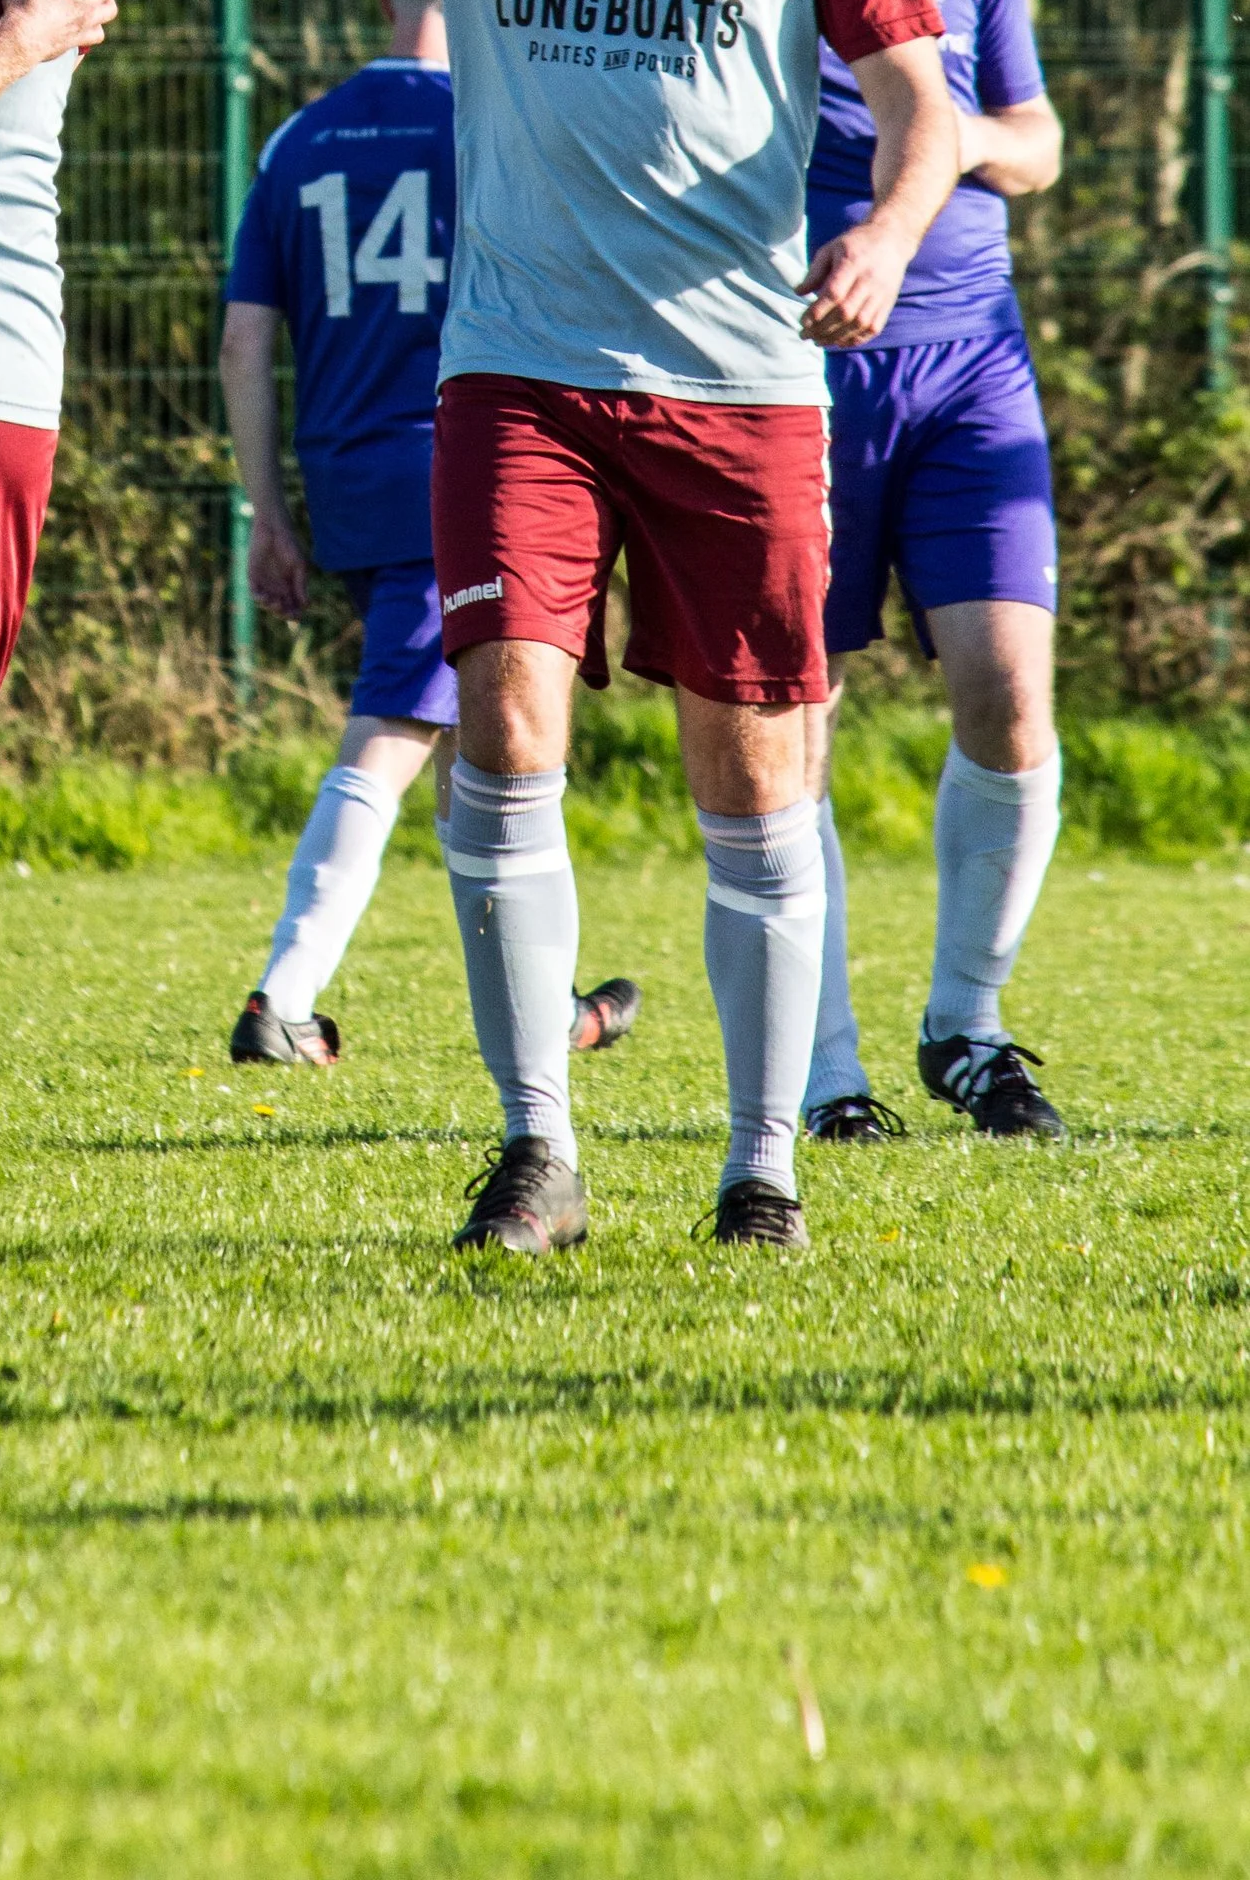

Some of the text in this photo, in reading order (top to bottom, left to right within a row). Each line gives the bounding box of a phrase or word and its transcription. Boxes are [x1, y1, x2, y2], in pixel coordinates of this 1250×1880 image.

[528, 40, 697, 78] PLATES AND POURS
[299, 170, 446, 318] 14
[442, 575, 504, 617] hummel
